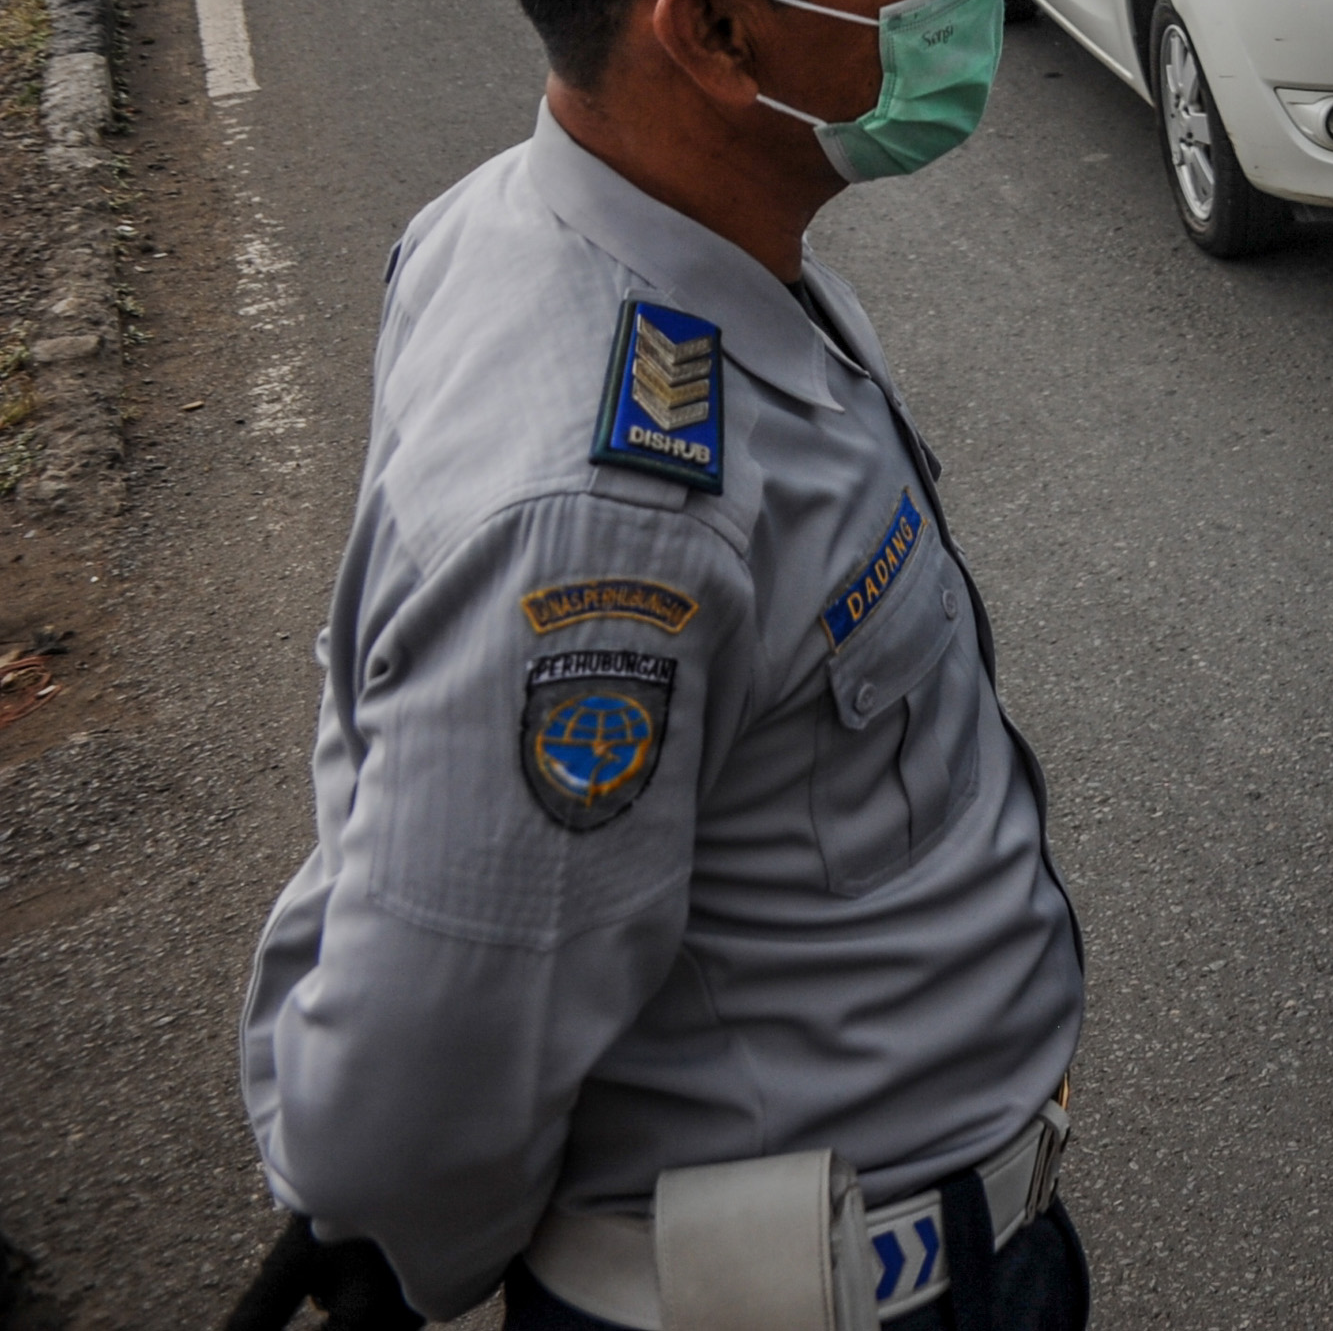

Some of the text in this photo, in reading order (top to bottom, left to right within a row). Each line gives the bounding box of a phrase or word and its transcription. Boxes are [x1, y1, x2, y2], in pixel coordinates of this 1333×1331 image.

[629, 424, 711, 465] DISHUB
[847, 516, 914, 620] DADANG
[535, 651, 672, 683] PERHUBUNGAN
